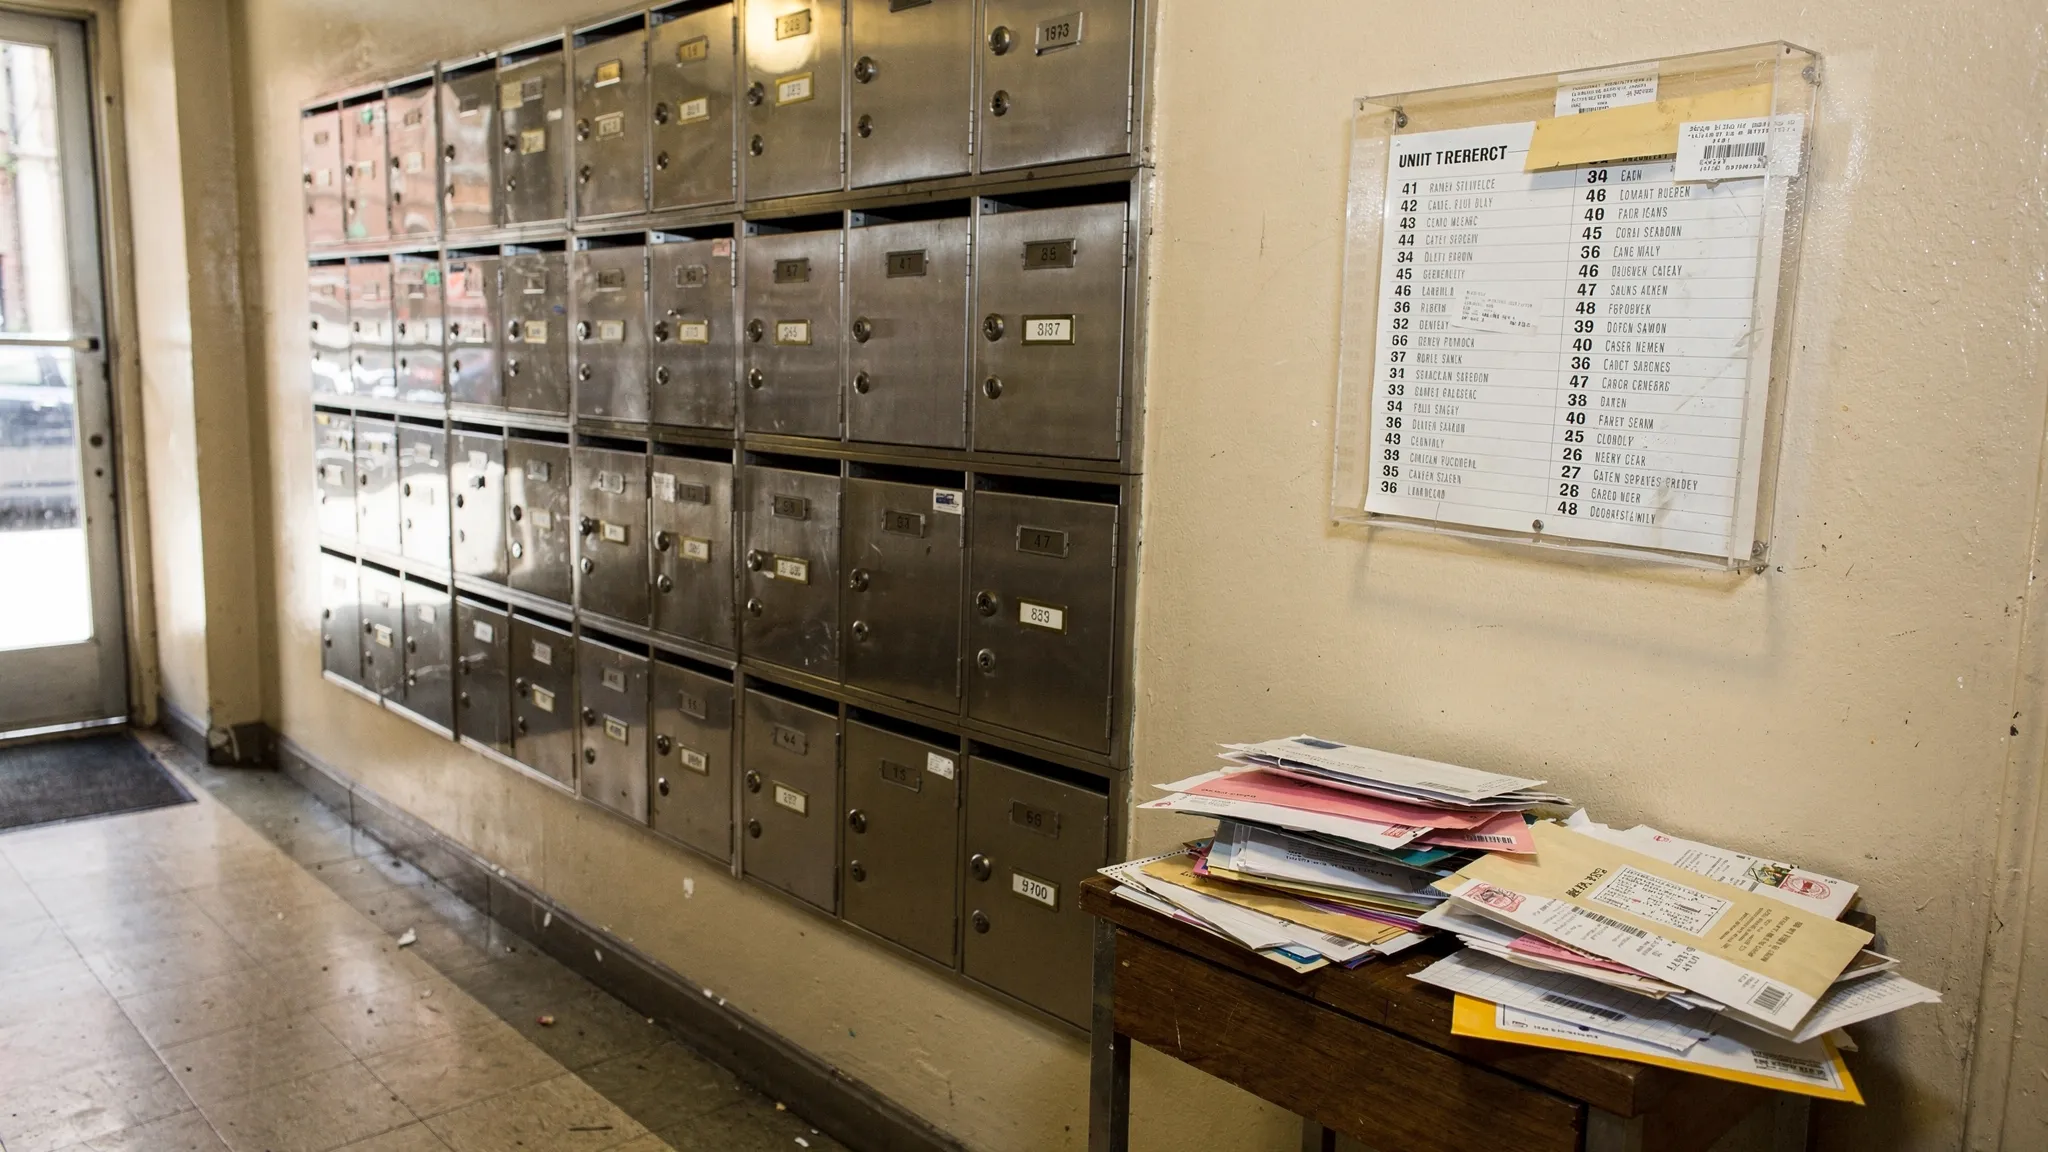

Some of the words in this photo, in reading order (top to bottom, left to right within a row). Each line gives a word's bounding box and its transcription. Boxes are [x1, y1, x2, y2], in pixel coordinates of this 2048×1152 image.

[1587, 169, 1608, 183] 34
[1402, 182, 1417, 195] 41
[1400, 200, 1418, 212] 42
[1584, 207, 1604, 221] 40
[1400, 217, 1416, 229] 43
[1582, 226, 1602, 240] 45
[1398, 234, 1414, 246] 44
[1397, 251, 1413, 263] 34
[1396, 268, 1412, 280] 45
[1579, 264, 1599, 277] 46
[1395, 285, 1411, 296] 46
[1577, 283, 1597, 296] 47
[1394, 302, 1410, 313] 36
[1576, 302, 1596, 315] 48
[1393, 318, 1409, 330] 32
[1574, 320, 1593, 333] 39
[1573, 338, 1592, 352] 40
[1391, 351, 1406, 362] 37
[1571, 356, 1590, 370] 36
[1570, 375, 1589, 388] 47
[1388, 384, 1404, 395] 33
[1387, 401, 1402, 412] 34
[1568, 394, 1587, 407] 38
[1386, 417, 1402, 428] 36
[1566, 412, 1586, 425] 40
[1385, 433, 1400, 445] 43
[1564, 430, 1584, 443] 25
[1563, 448, 1583, 461] 26
[1383, 465, 1399, 477] 35
[1561, 465, 1581, 479] 27
[1381, 481, 1397, 493] 36
[1558, 501, 1578, 516] 48
